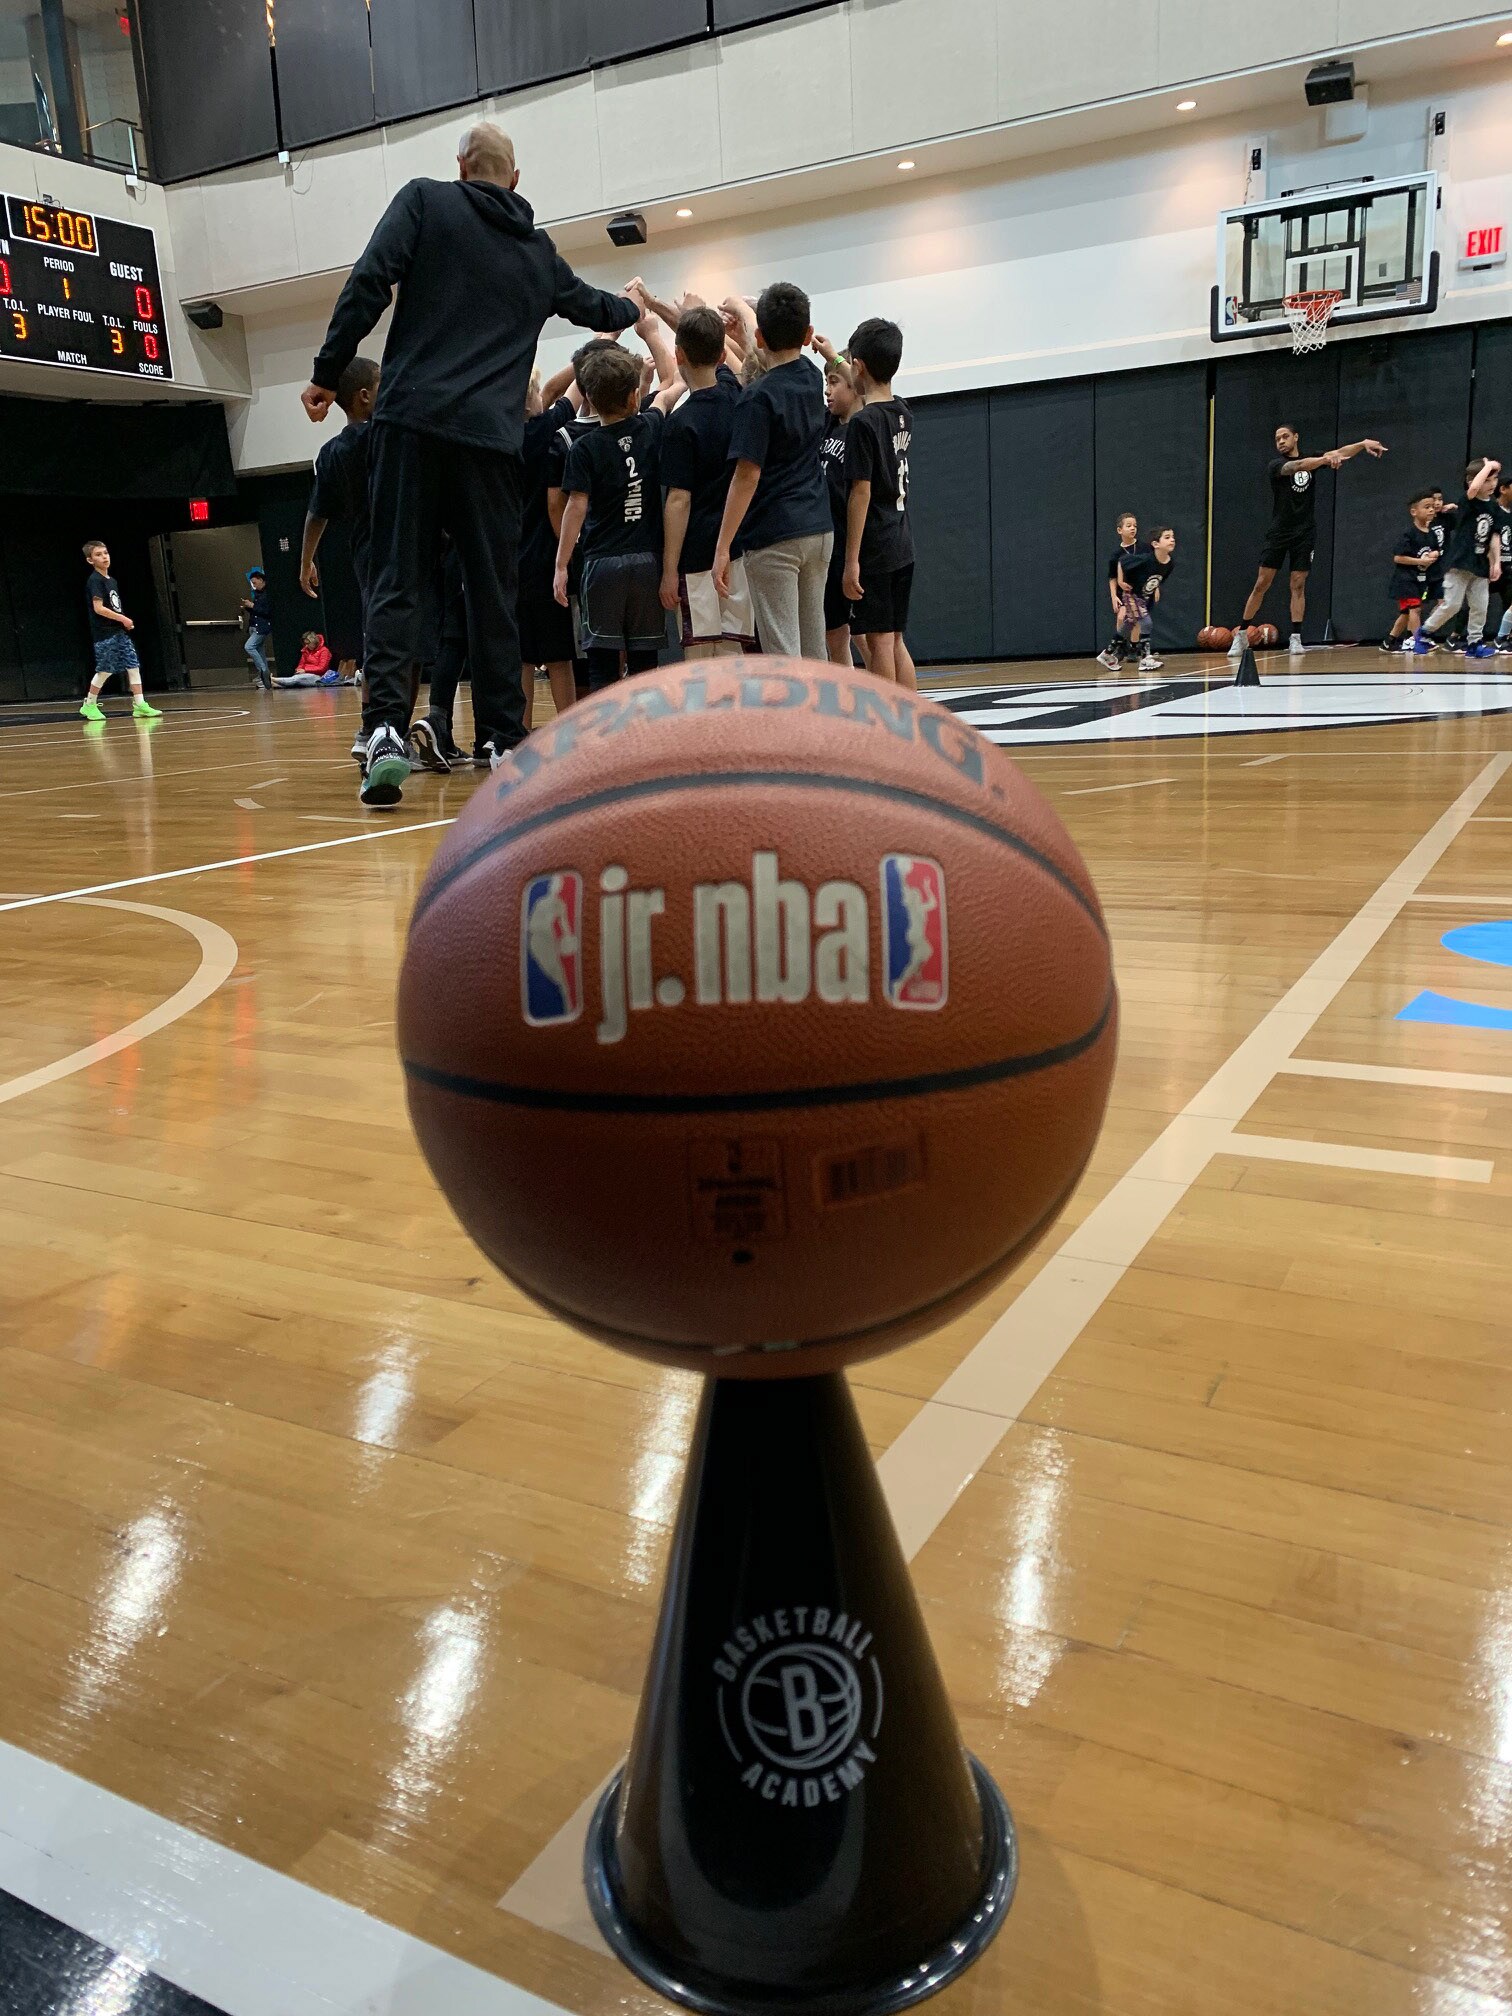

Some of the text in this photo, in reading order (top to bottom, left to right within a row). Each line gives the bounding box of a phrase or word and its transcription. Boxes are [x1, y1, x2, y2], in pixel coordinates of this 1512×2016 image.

[23, 204, 94, 249] 15:00
[1466, 226, 1503, 257] EXIT
[43, 256, 75, 273] PERIOD
[109, 261, 143, 282] GUEST
[3, 297, 29, 313] T.O.L.
[37, 303, 95, 324] PLAYER FOUL
[135, 286, 153, 319] 0
[12, 313, 27, 340] 3
[102, 315, 126, 329] T.O.L.
[132, 320, 158, 335] FOULS
[110, 329, 123, 354] 3
[144, 334, 158, 359] 0
[57, 350, 88, 365] MATCH
[138, 362, 164, 376] SCORE
[625, 456, 639, 478] 2
[496, 674, 987, 800] SPALDING
[713, 1606, 874, 1682] BASKETBALL
[740, 1738, 877, 1808] ACADEMY
